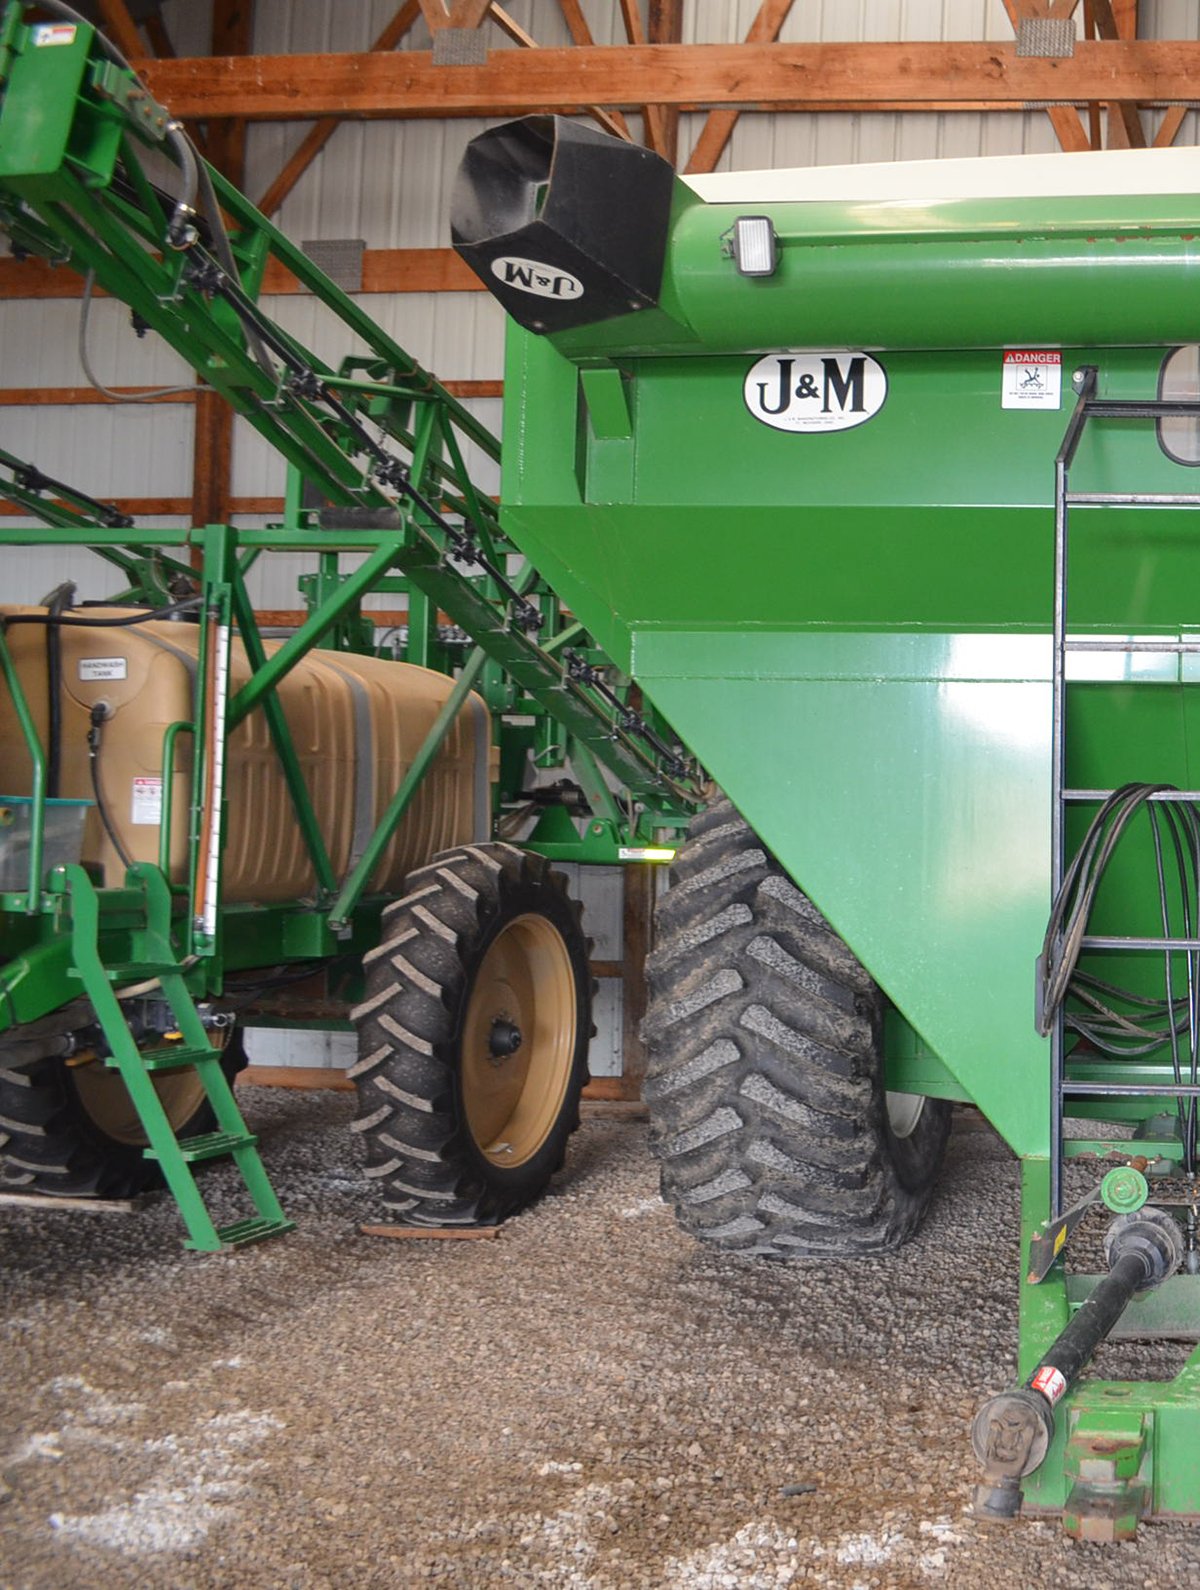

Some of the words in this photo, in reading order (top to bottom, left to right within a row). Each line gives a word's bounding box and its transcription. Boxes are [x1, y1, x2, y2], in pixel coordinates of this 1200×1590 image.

[503, 260, 576, 296] J&M
[1015, 353, 1061, 363] DANGER
[756, 357, 868, 414] J&M
